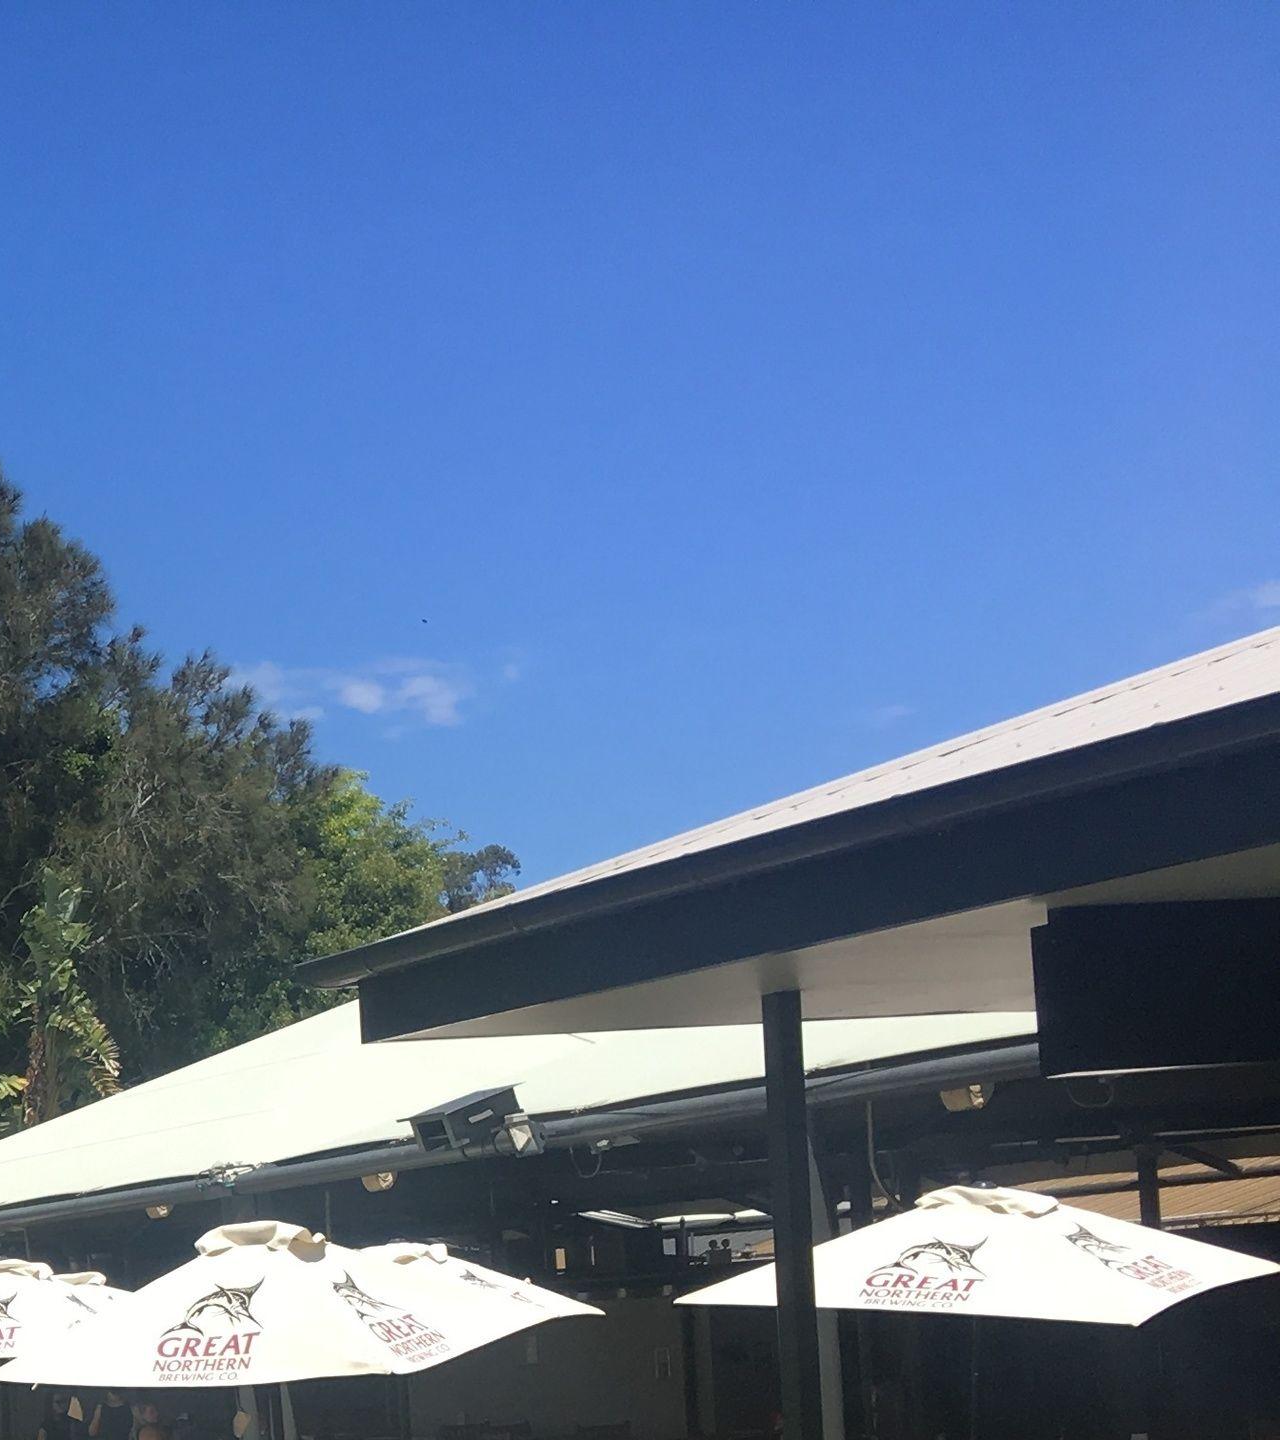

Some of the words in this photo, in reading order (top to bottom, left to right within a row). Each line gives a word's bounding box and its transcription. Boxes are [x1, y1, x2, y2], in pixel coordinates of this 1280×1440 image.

[1116, 1255, 1173, 1280] GREAT
[865, 1273, 985, 1292] GREAT
[859, 1289, 971, 1302] NORTHERN
[864, 1298, 926, 1307] BREWING
[368, 1314, 429, 1343] GREAT
[157, 1332, 261, 1358] GREAT
[389, 1330, 446, 1358] NORTHERN
[152, 1357, 252, 1372] NORTHERN
[158, 1373, 214, 1382] BREWING
